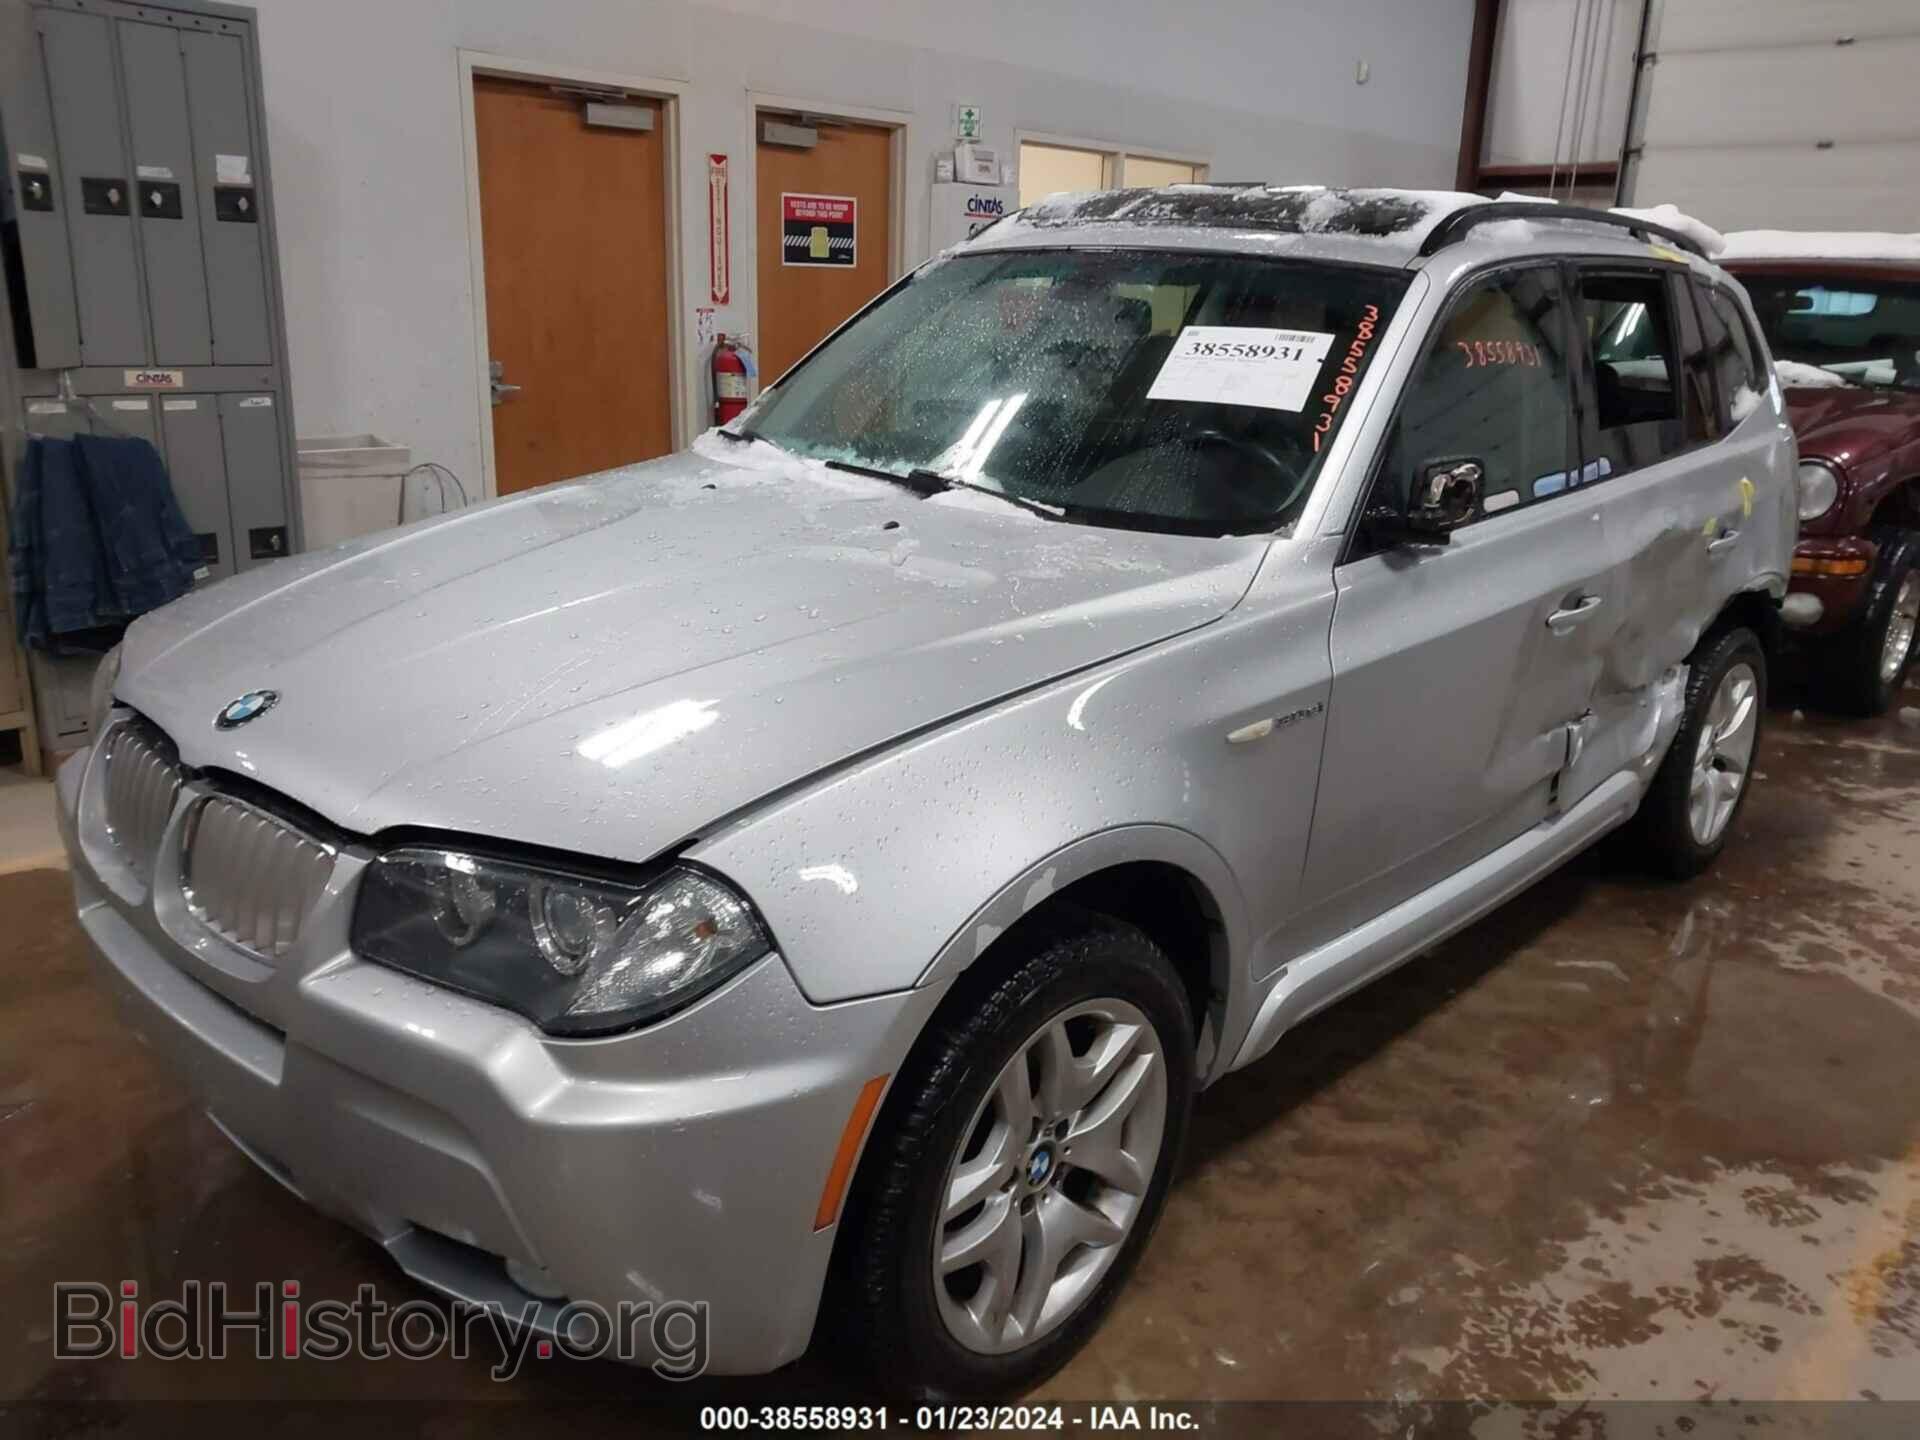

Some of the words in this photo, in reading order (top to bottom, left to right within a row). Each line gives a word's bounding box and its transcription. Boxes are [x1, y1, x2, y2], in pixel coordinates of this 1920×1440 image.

[1185, 342, 1303, 361] 38558931
[1457, 341, 1542, 368] 38558931
[1313, 305, 1379, 452] 38558931
